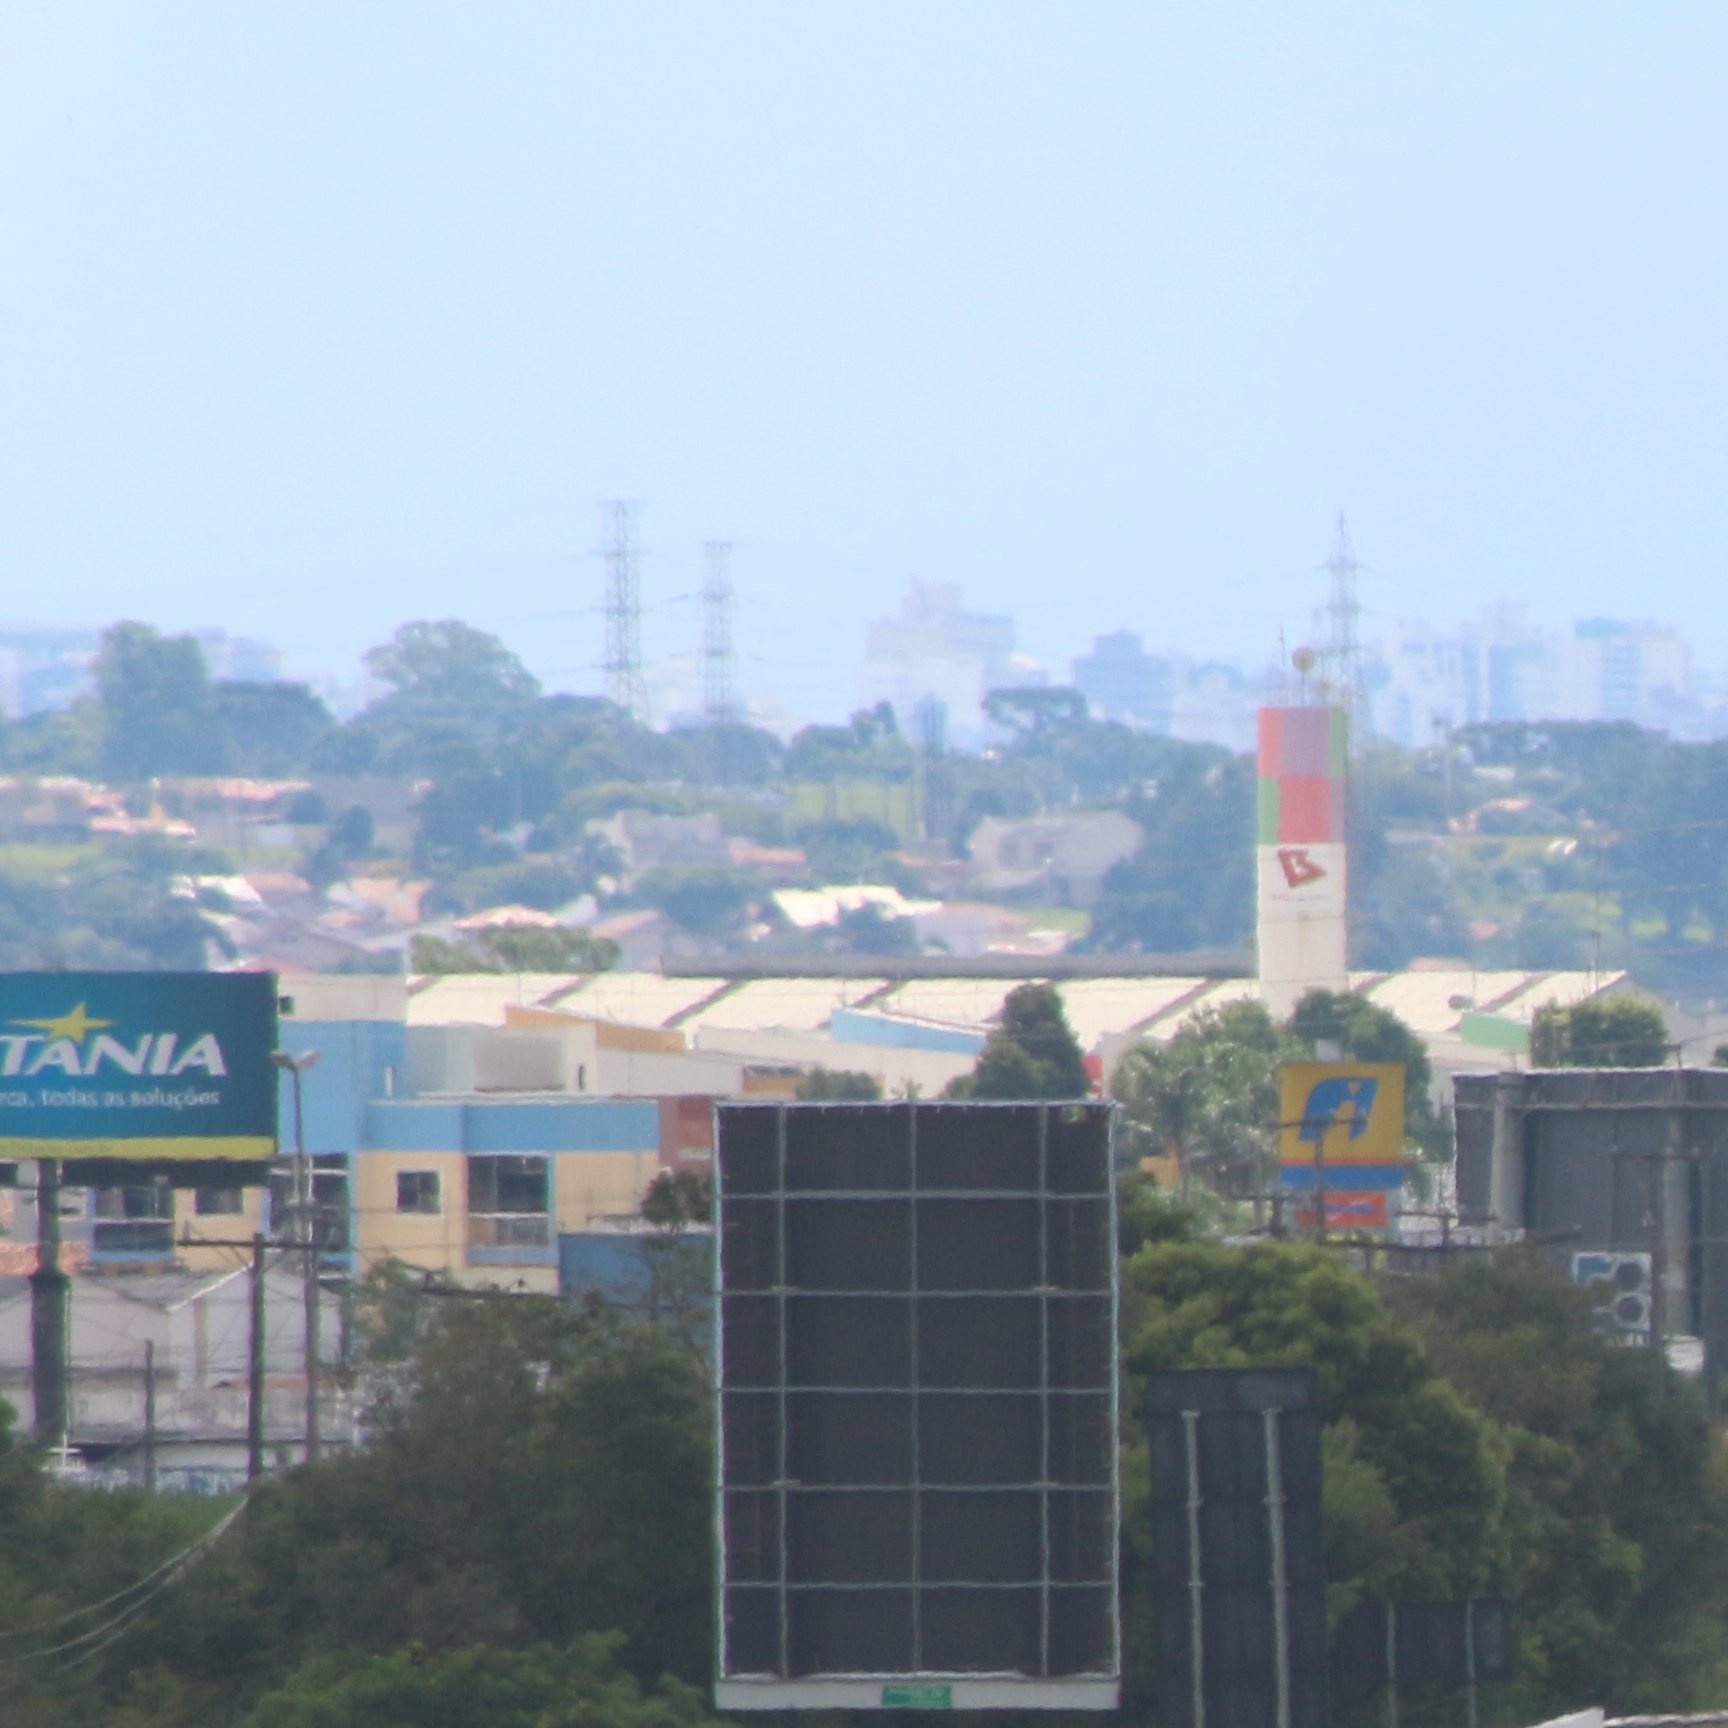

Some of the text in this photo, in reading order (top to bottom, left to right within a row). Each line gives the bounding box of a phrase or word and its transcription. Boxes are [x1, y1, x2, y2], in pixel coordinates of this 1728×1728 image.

[42, 1088, 98, 1106] todas
[104, 1091, 125, 1106] as
[131, 1087, 221, 1111] soluções
